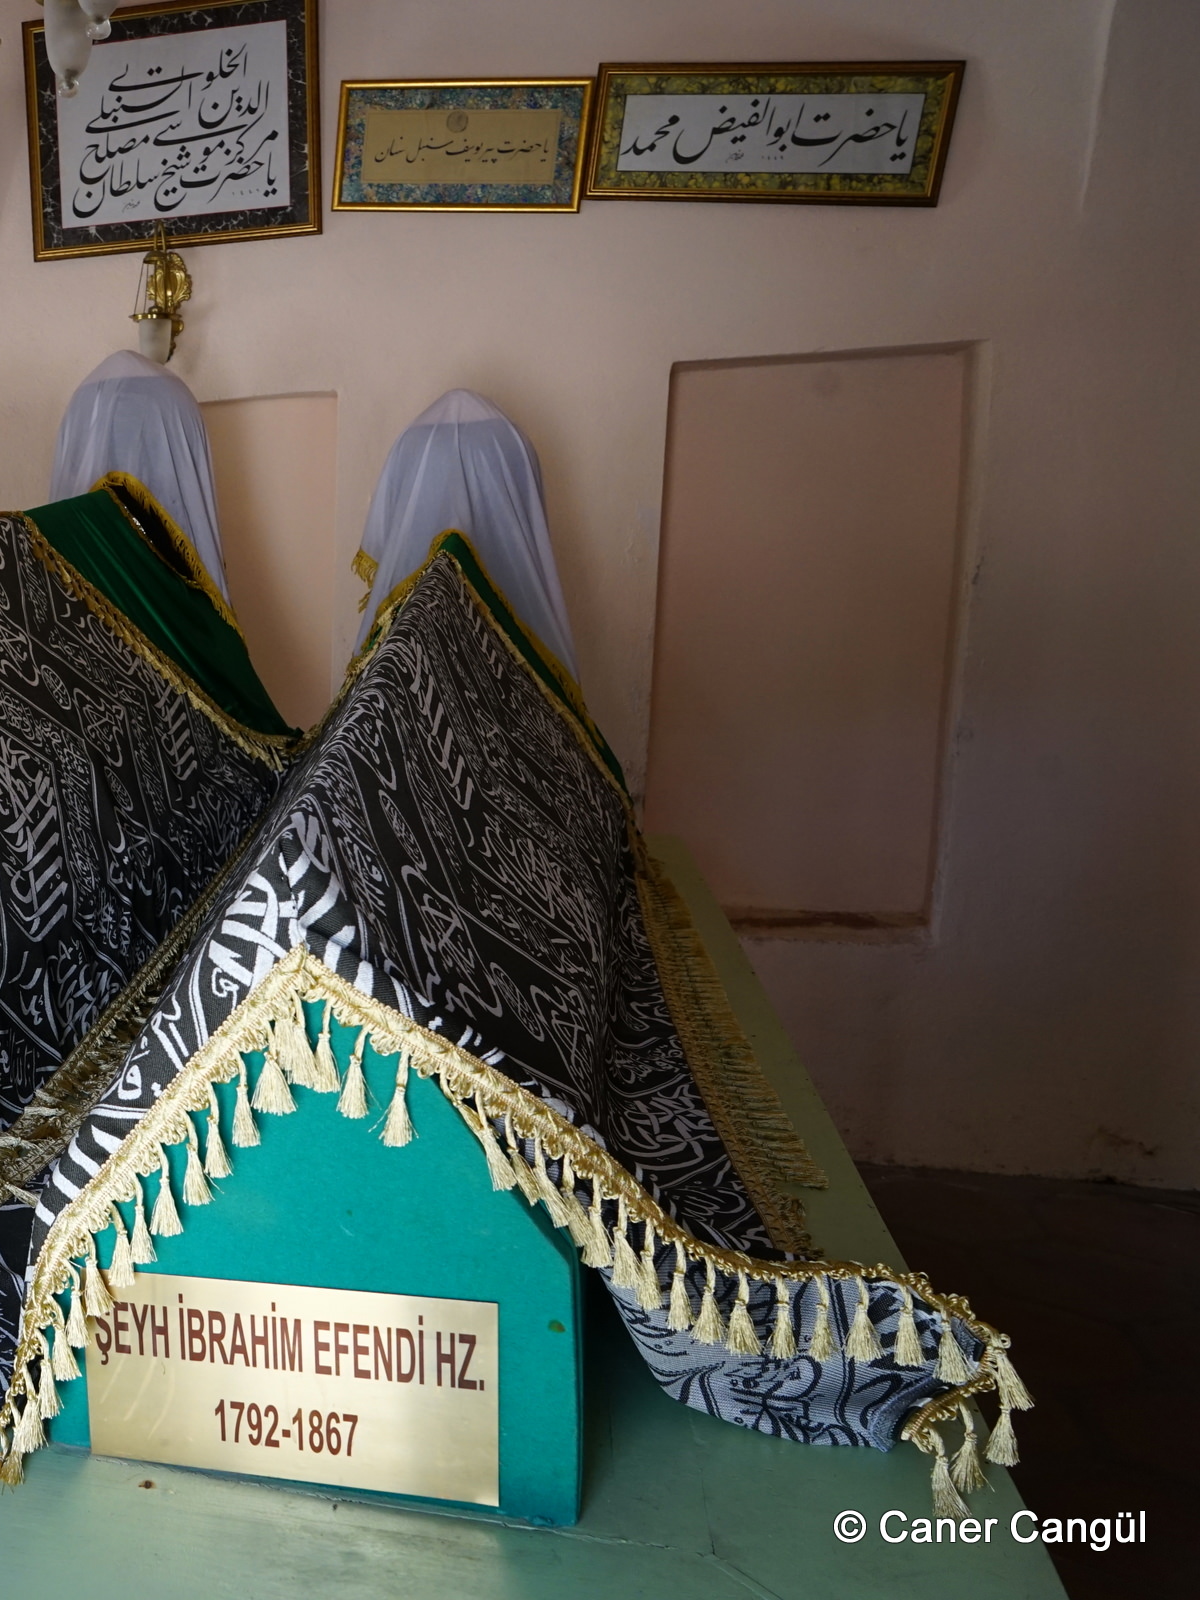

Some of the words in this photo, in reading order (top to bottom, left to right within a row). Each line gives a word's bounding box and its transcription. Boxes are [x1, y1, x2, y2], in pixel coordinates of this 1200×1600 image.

[95, 1301, 170, 1366] ŞEYH
[178, 1293, 303, 1373] İBRAHİM
[313, 1315, 425, 1386] EFENDİ
[436, 1331, 485, 1391] HZ.
[215, 1398, 359, 1457] 1792-1867
